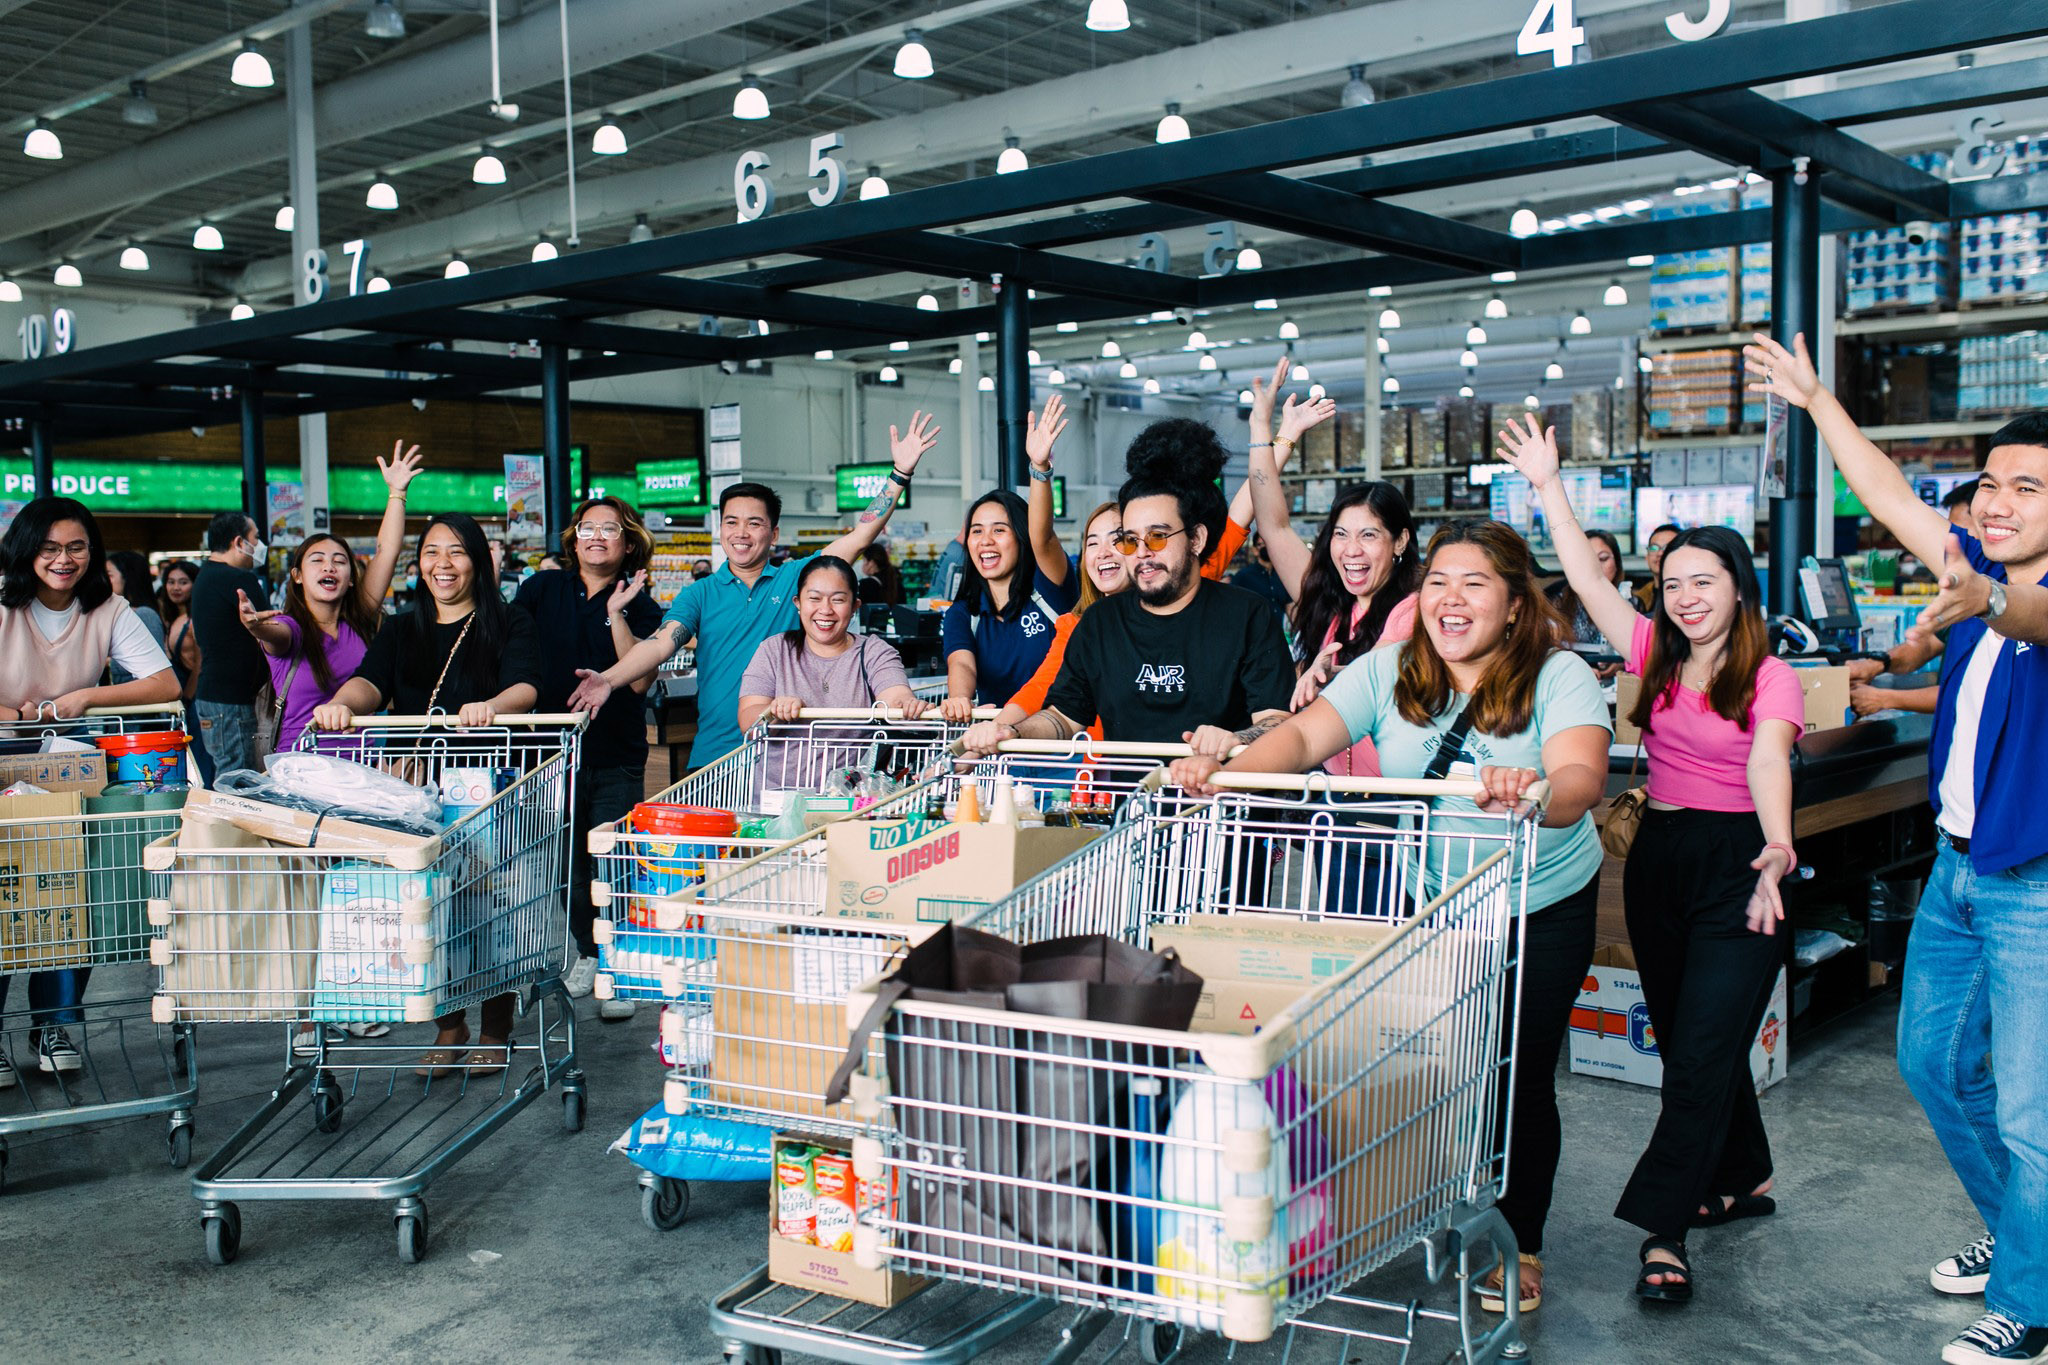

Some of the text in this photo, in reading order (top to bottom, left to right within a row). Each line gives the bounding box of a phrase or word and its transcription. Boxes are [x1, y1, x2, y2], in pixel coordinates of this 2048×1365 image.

[1517, 0, 1587, 67] 4
[808, 132, 848, 207] 5
[734, 150, 775, 220] 6
[303, 248, 329, 302] 8
[343, 239, 371, 296] 7
[17, 314, 46, 360] 10
[54, 308, 75, 354] 9
[4, 474, 130, 495] PRDUCE
[645, 475, 691, 489] POULTRY
[1020, 611, 1040, 628] OP
[1023, 623, 1046, 638] 360
[1135, 664, 1186, 685] AIR
[1139, 683, 1184, 692] NIKE
[1422, 734, 1440, 752] IT'S
[1477, 743, 1494, 760] DAY
[871, 826, 900, 849] OIL
[887, 831, 960, 884] BAGUIO
[3, 890, 18, 903] kg
[352, 916, 402, 926] AT HOME
[1614, 981, 1640, 990] PPLES
[1601, 1062, 1625, 1070] PRODUCE
[818, 1203, 841, 1214] Four
[809, 1262, 839, 1276] 57525
